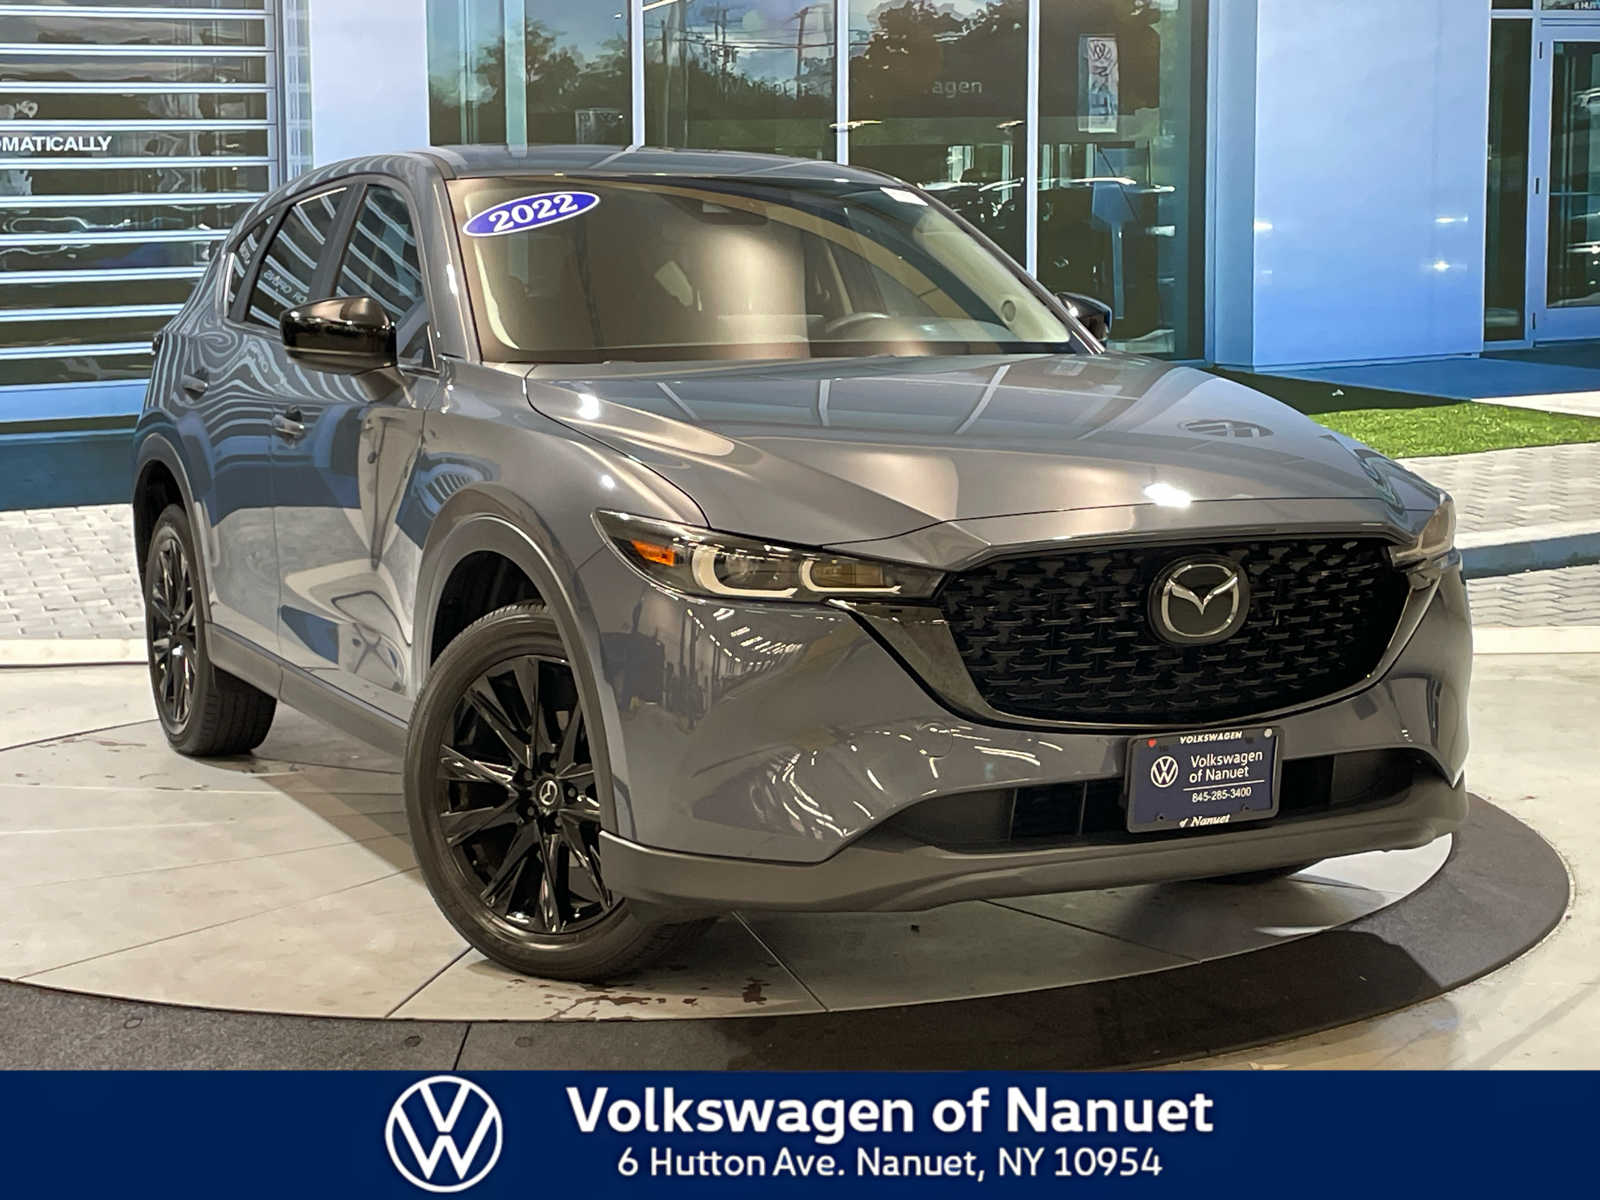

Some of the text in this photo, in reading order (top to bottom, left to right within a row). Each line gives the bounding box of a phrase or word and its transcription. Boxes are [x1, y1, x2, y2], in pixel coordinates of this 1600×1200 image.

[0, 136, 112, 152] MATICALLY
[488, 194, 579, 232] 2022
[1180, 731, 1243, 745] VOLKSWAGEN
[1191, 751, 1263, 768] Volkswagen
[1189, 766, 1249, 784] of Nanuet
[1192, 786, 1252, 803] 845-285-3400
[1190, 813, 1231, 827] Nanuet
